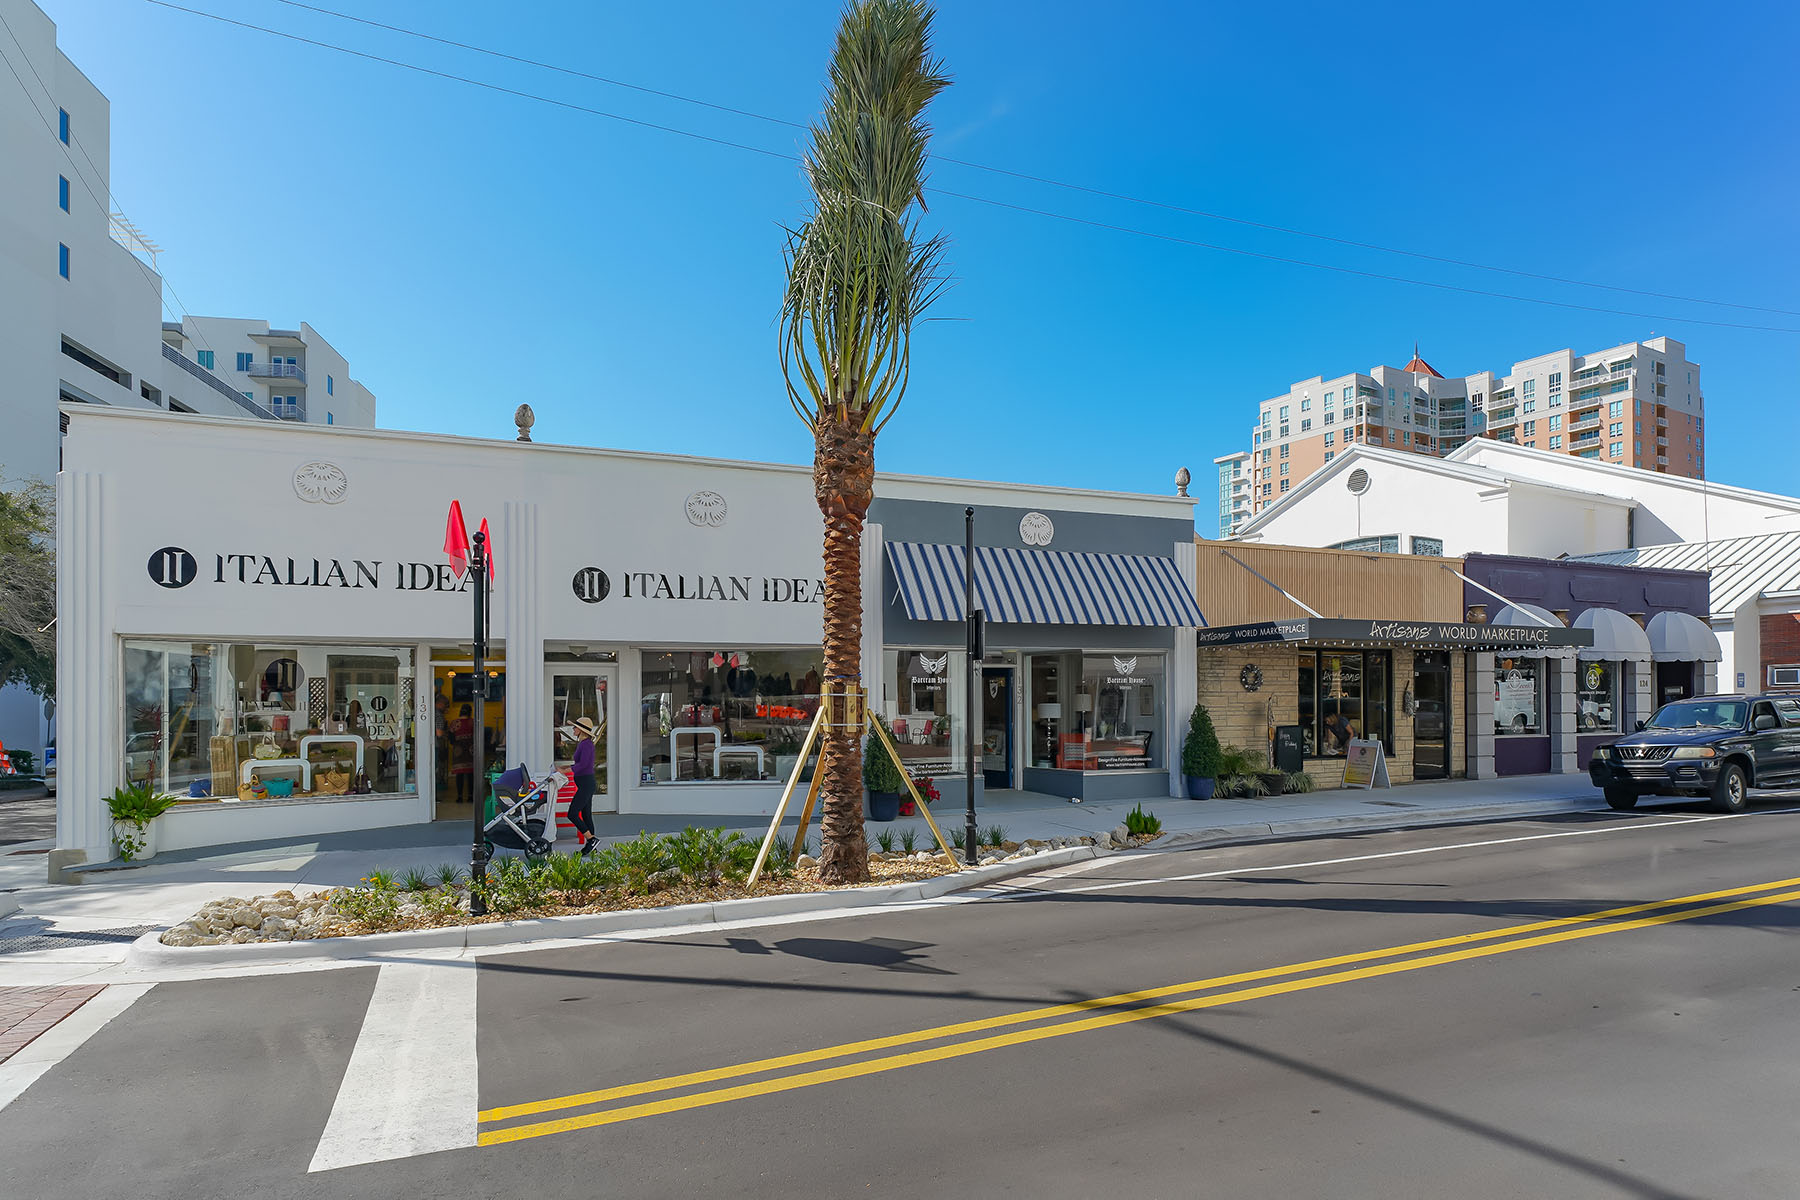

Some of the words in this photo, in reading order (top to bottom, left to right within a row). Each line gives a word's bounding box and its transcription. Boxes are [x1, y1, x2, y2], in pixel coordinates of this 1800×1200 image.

[213, 553, 383, 589] ITALIAN
[622, 571, 752, 601] ITALIAN
[1234, 629, 1258, 638] WORLD
[1259, 623, 1306, 636] MARKETPLACE
[1438, 625, 1478, 640] WORLD
[1481, 627, 1549, 642] MARKETPLACE
